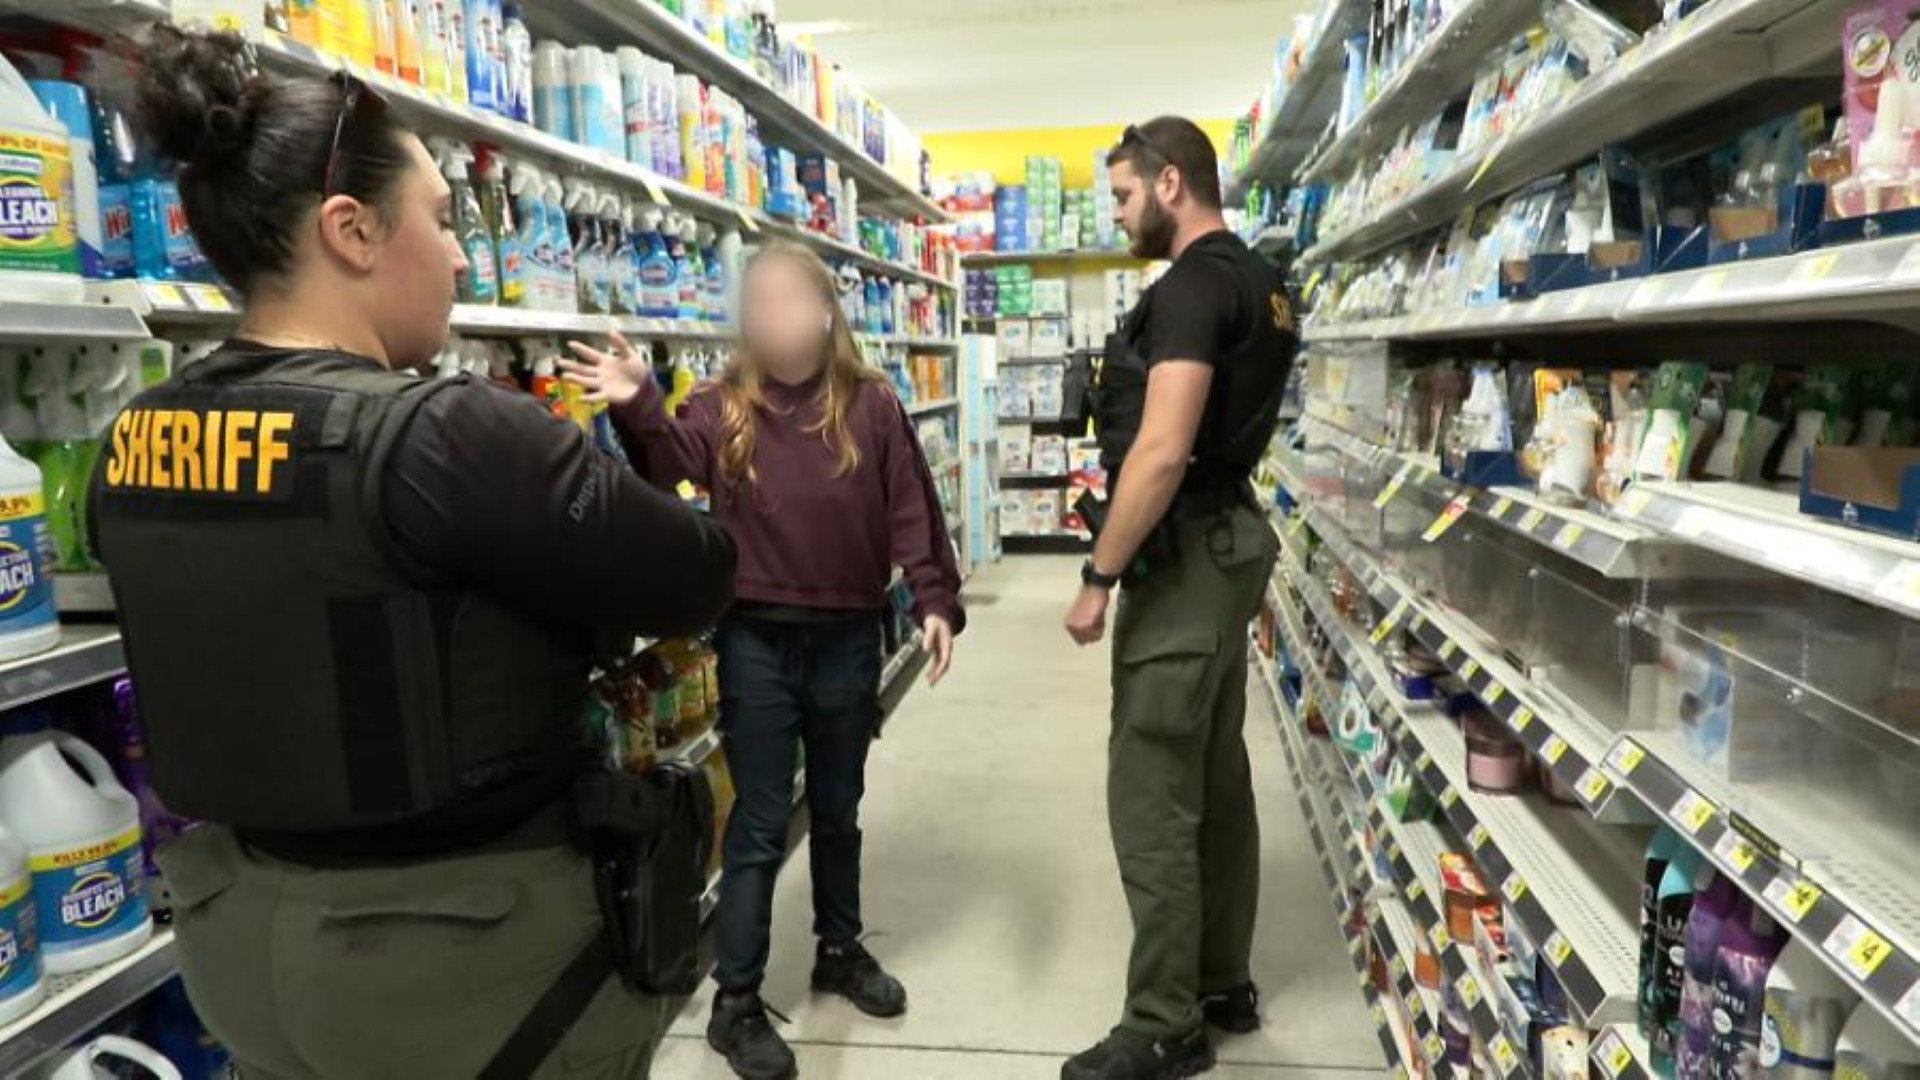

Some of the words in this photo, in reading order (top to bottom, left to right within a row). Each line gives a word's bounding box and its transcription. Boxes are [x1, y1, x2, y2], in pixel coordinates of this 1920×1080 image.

[0, 199, 58, 224] LEACH
[106, 408, 295, 493] SHERIFF
[0, 561, 34, 594] ACH
[62, 883, 125, 925] BLEACH
